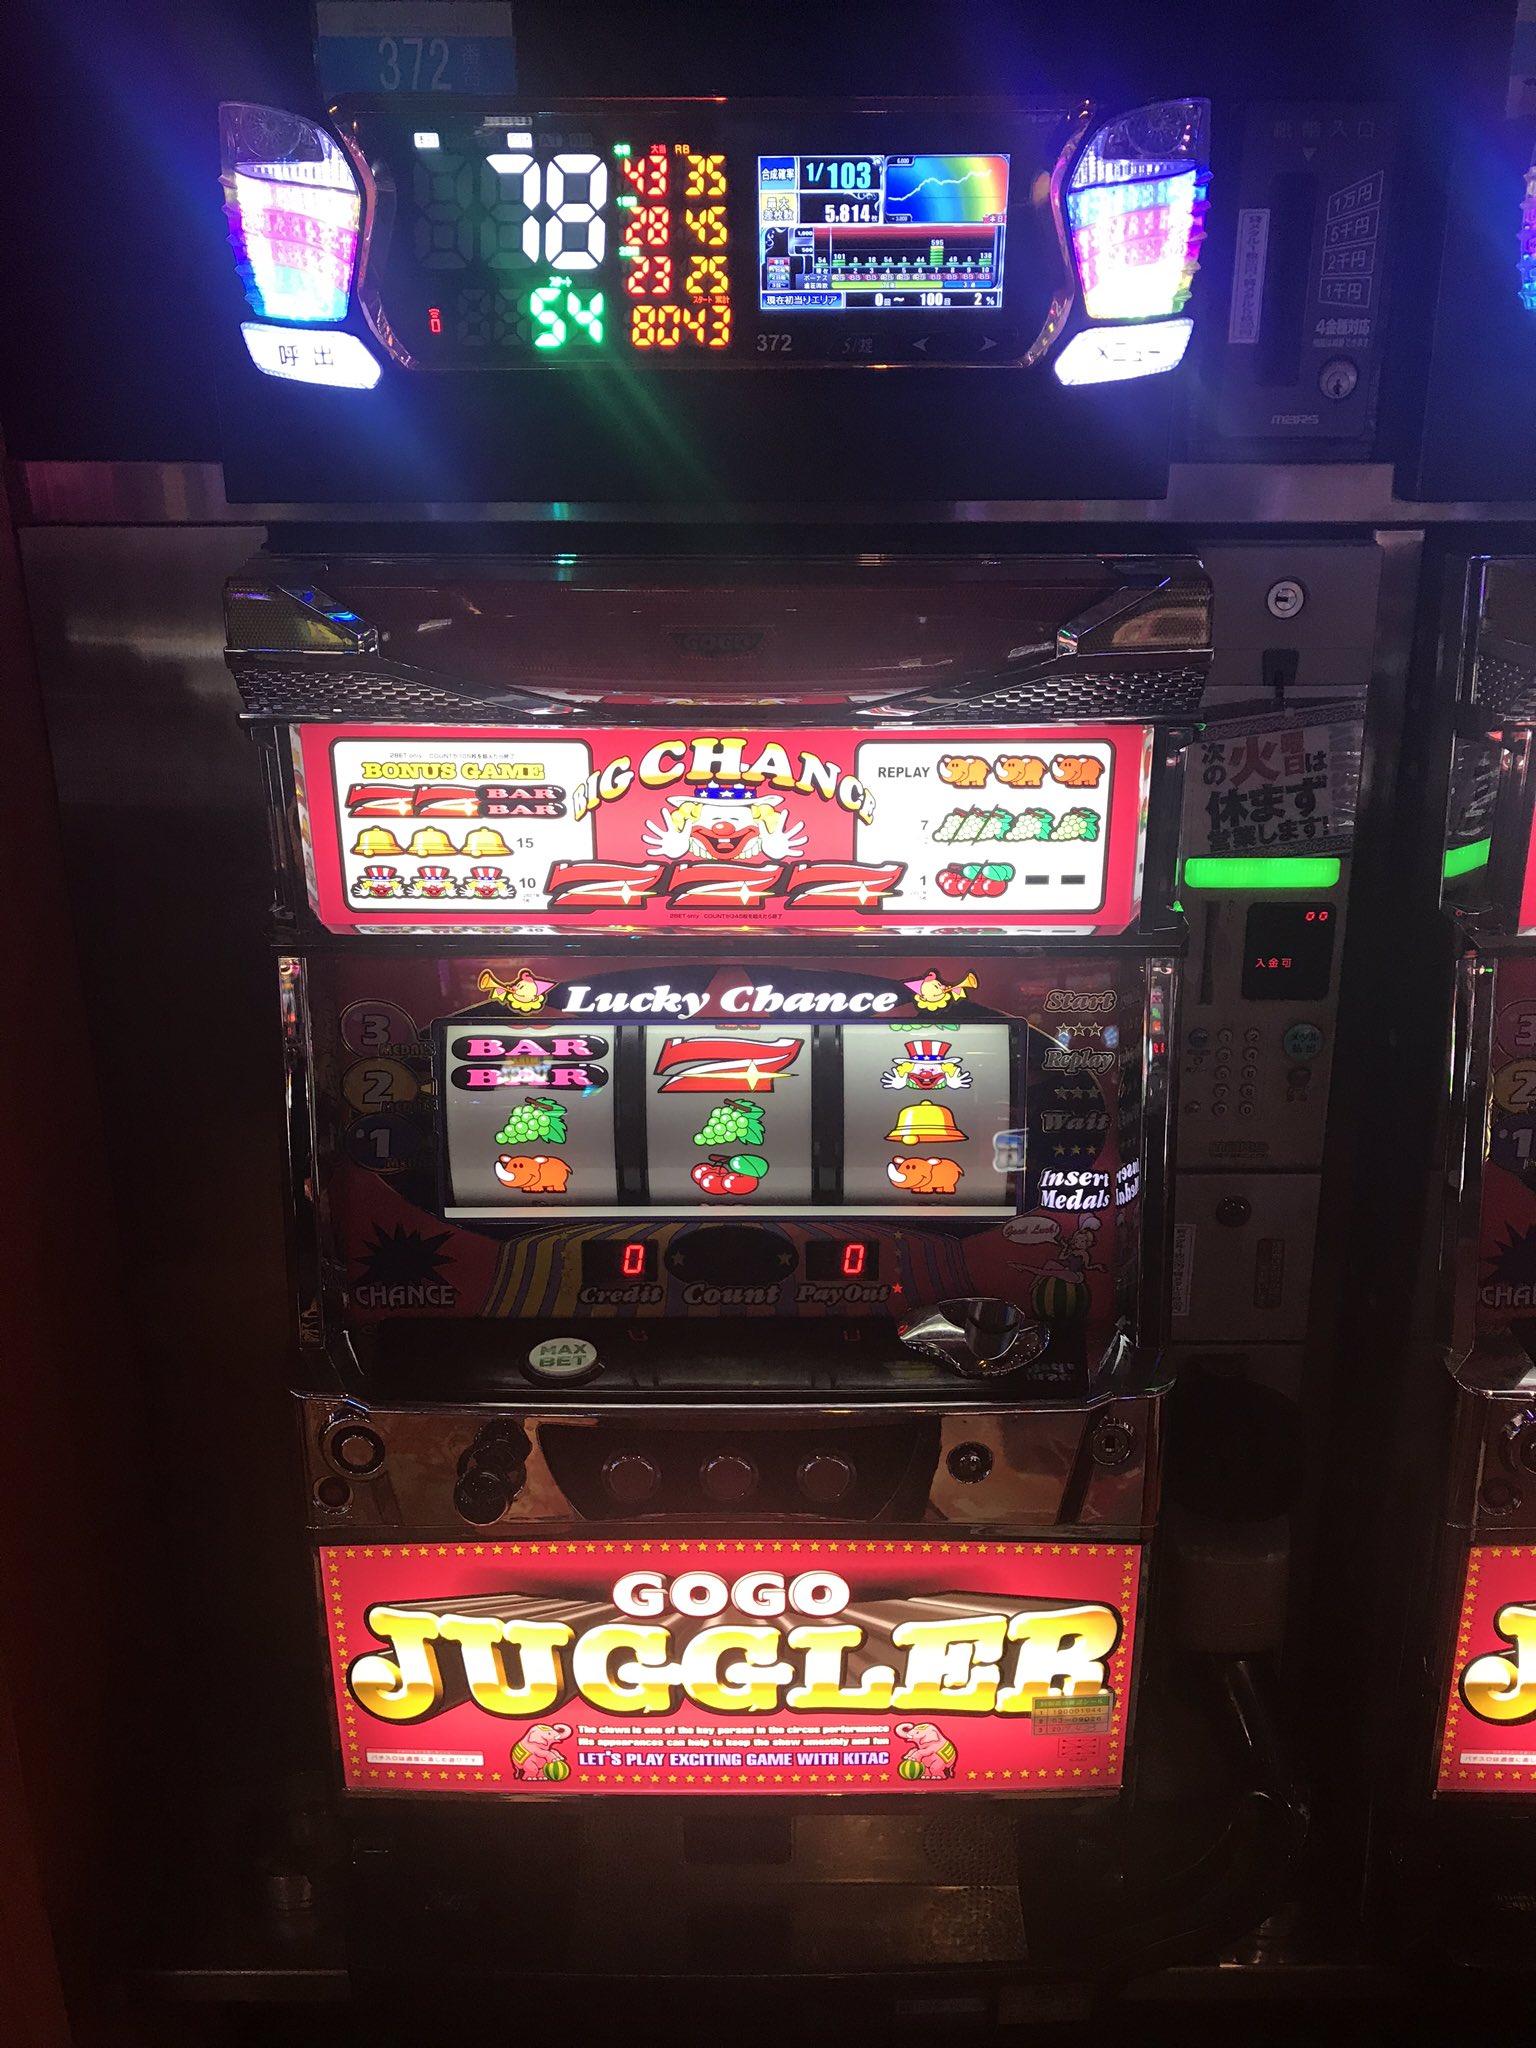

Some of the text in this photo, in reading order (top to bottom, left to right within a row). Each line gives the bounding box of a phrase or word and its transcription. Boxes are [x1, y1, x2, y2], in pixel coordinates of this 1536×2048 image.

[379, 36, 452, 91] 372
[674, 144, 690, 154] RB
[624, 155, 668, 195] 43
[685, 155, 727, 196] 35
[806, 162, 872, 189] 1/103
[1333, 182, 1373, 213] 1万円
[486, 154, 608, 270] 78
[626, 206, 669, 245] 28
[685, 206, 728, 246] 45
[1331, 215, 1370, 243] 5千円
[1327, 249, 1367, 270] 2千円
[628, 256, 671, 295] 23
[686, 256, 729, 295] 25
[766, 295, 838, 305] 現在初当りエリア
[1325, 282, 1362, 300] 1千円
[531, 287, 604, 347] 54
[632, 305, 732, 346] 8043
[756, 334, 793, 352] 372
[360, 761, 545, 781] BONUS GAME
[877, 766, 930, 779] REPLAY
[485, 787, 558, 800] BAR
[486, 803, 560, 816] BAR
[920, 819, 929, 832] 7
[516, 837, 534, 850] 15
[519, 877, 537, 890] 10
[919, 876, 927, 887] 1
[1255, 957, 1293, 969] 入金可
[562, 984, 899, 1020] Lucky Chance
[1047, 990, 1116, 1011] Start
[362, 1014, 391, 1046] 3
[466, 1038, 594, 1057] BAR
[1045, 1047, 1115, 1075] Replay
[362, 1070, 394, 1105] 2
[1043, 1110, 1112, 1133] Wait
[369, 1128, 392, 1160] 1
[1512, 1128, 1534, 1159] 1
[1040, 1169, 1109, 1188] Insert
[1040, 1188, 1111, 1211] Medals
[623, 1244, 645, 1275] 0
[842, 1244, 865, 1275] 0
[355, 1284, 456, 1308] CHANCE
[580, 1285, 663, 1304] Credit
[683, 1283, 781, 1305] Count
[797, 1283, 890, 1305] PayOut
[539, 1343, 588, 1356] MAX
[539, 1355, 587, 1368] BET
[612, 1570, 851, 1618] GOGO
[350, 1604, 1120, 1722] JUGGLER
[577, 1737, 890, 1747] His appearances can help to keep the show smoothly and fun
[578, 1725, 890, 1736] The clown is one of the key person in the circus performance
[578, 1751, 890, 1766] LET'S PLAY EXCITING GAME WITH KITAC
